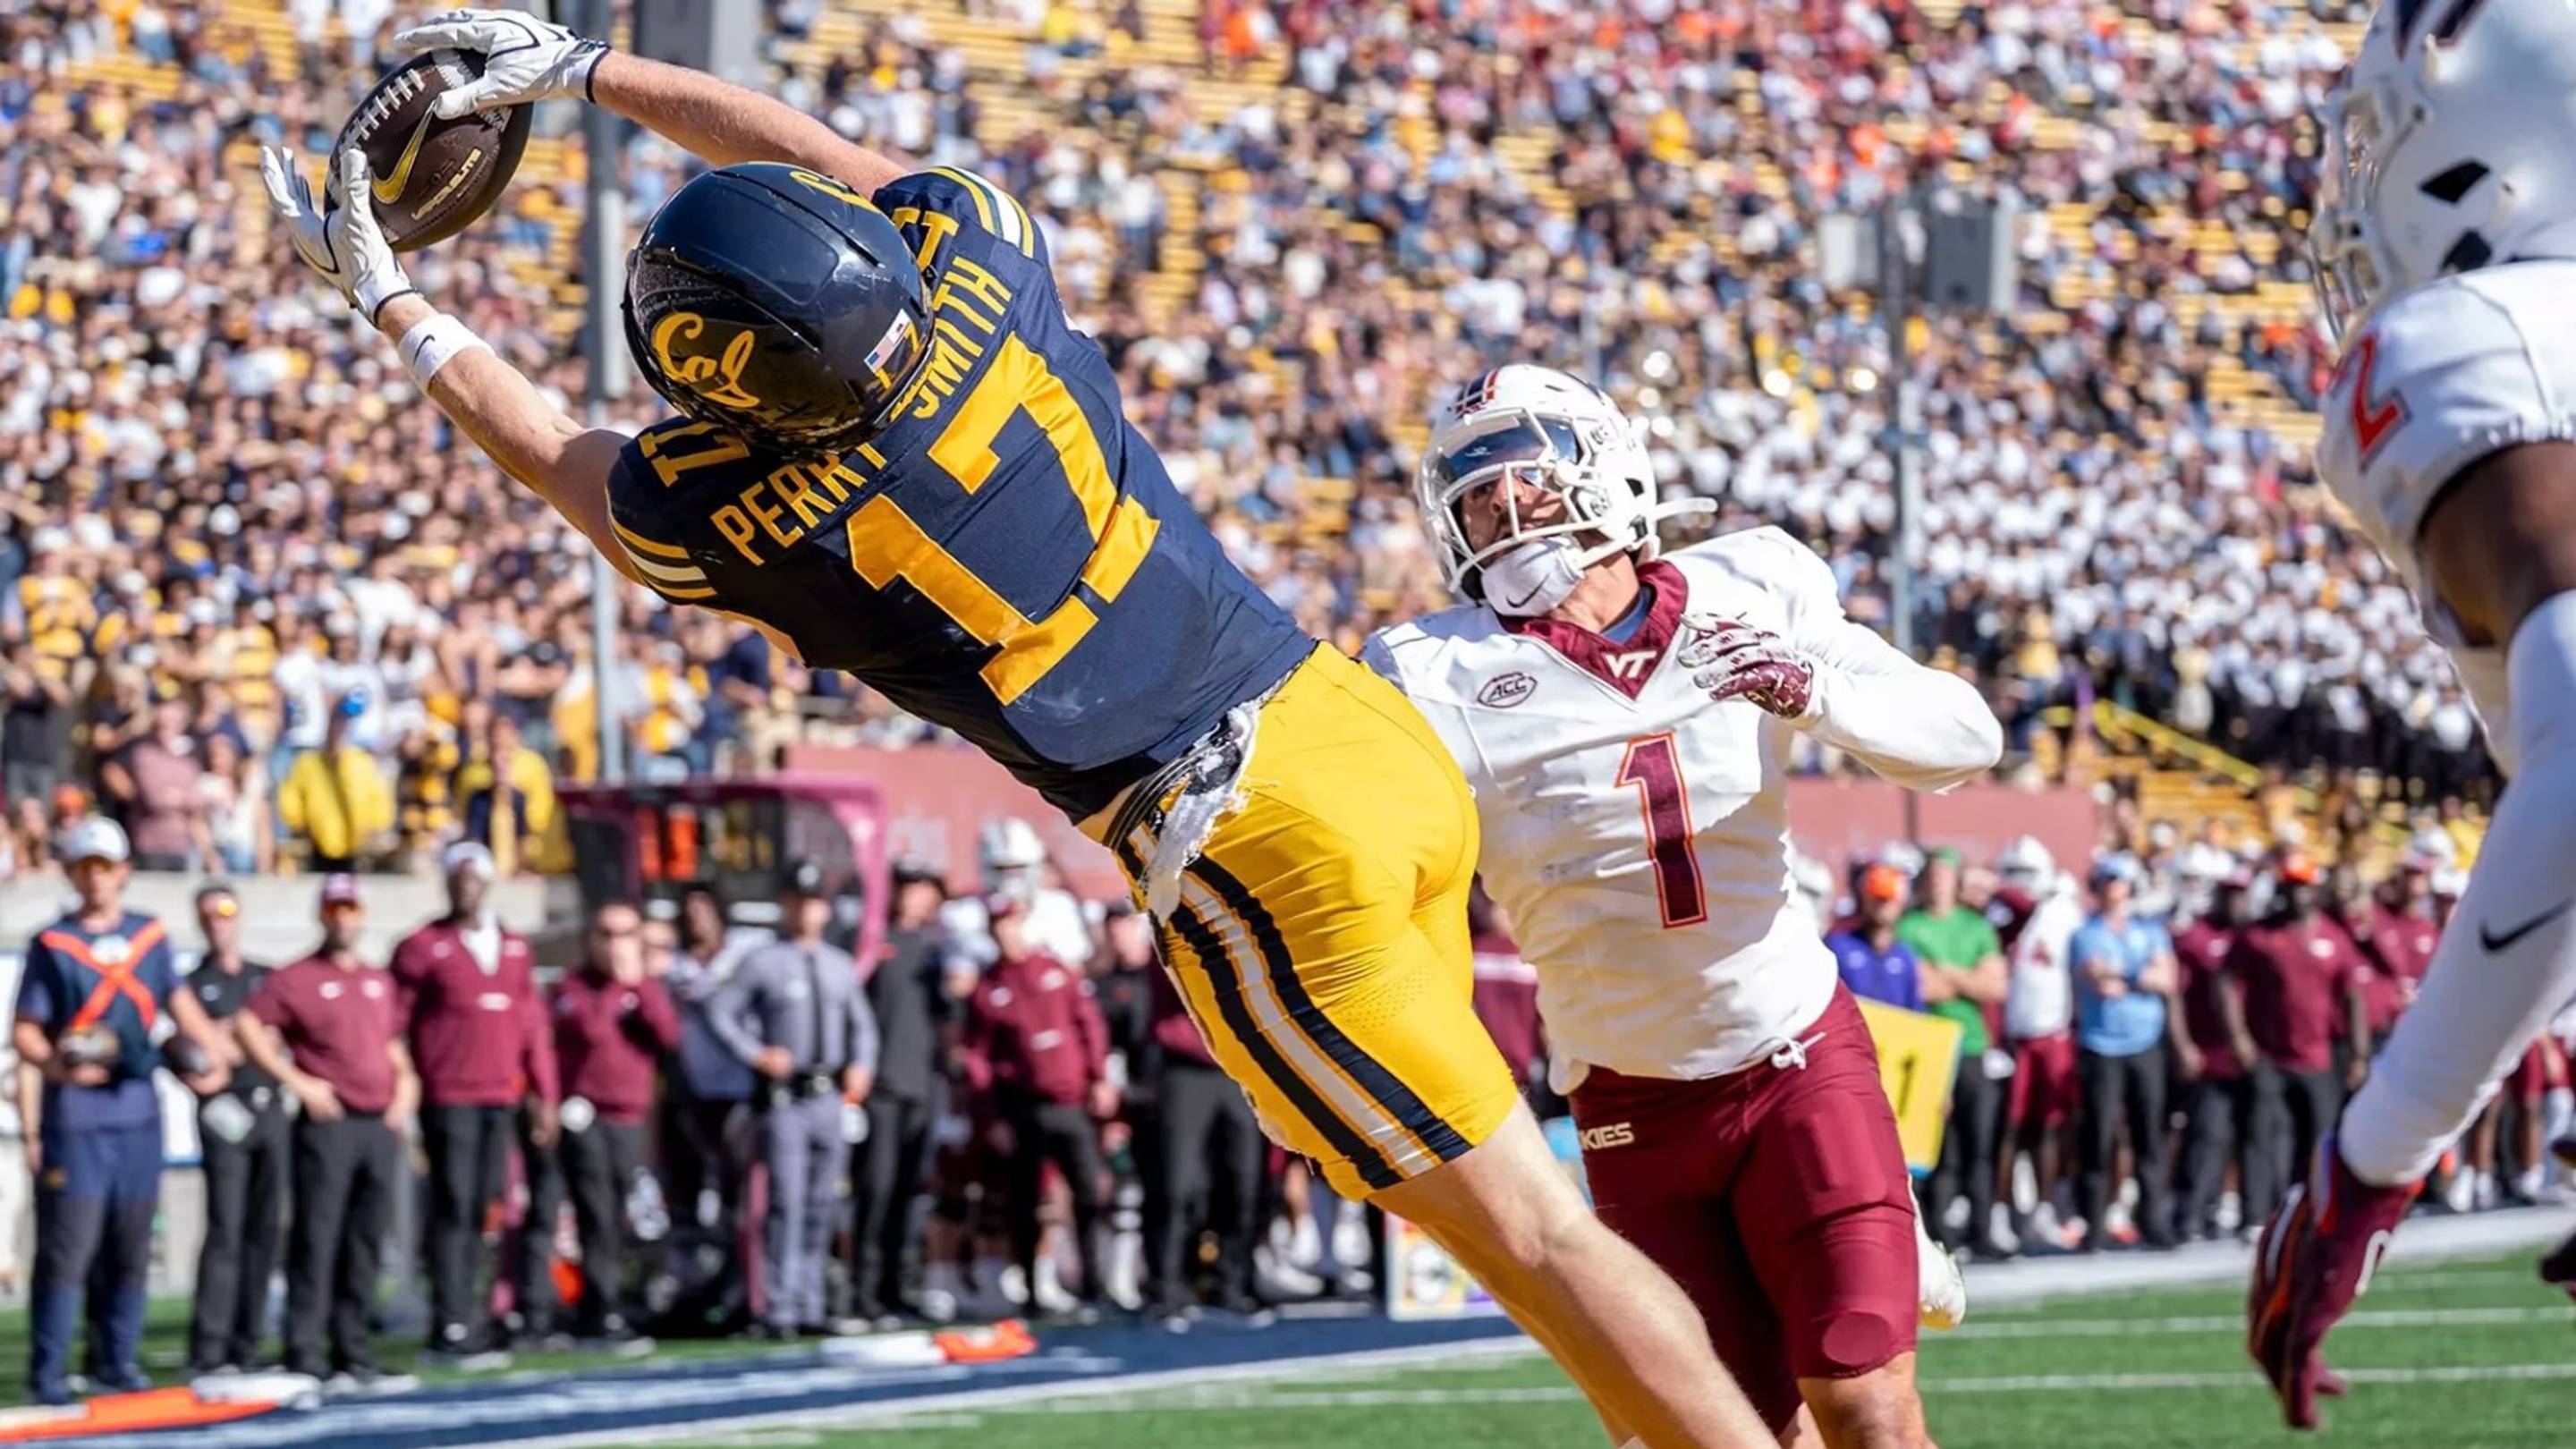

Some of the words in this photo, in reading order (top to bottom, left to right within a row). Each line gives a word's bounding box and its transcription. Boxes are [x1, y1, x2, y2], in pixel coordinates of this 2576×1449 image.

[651, 311, 760, 408] Cal
[847, 331, 1160, 706] 17
[1487, 678, 1528, 703] ACC
[1601, 649, 1657, 679] VT
[1614, 730, 1707, 929] 1
